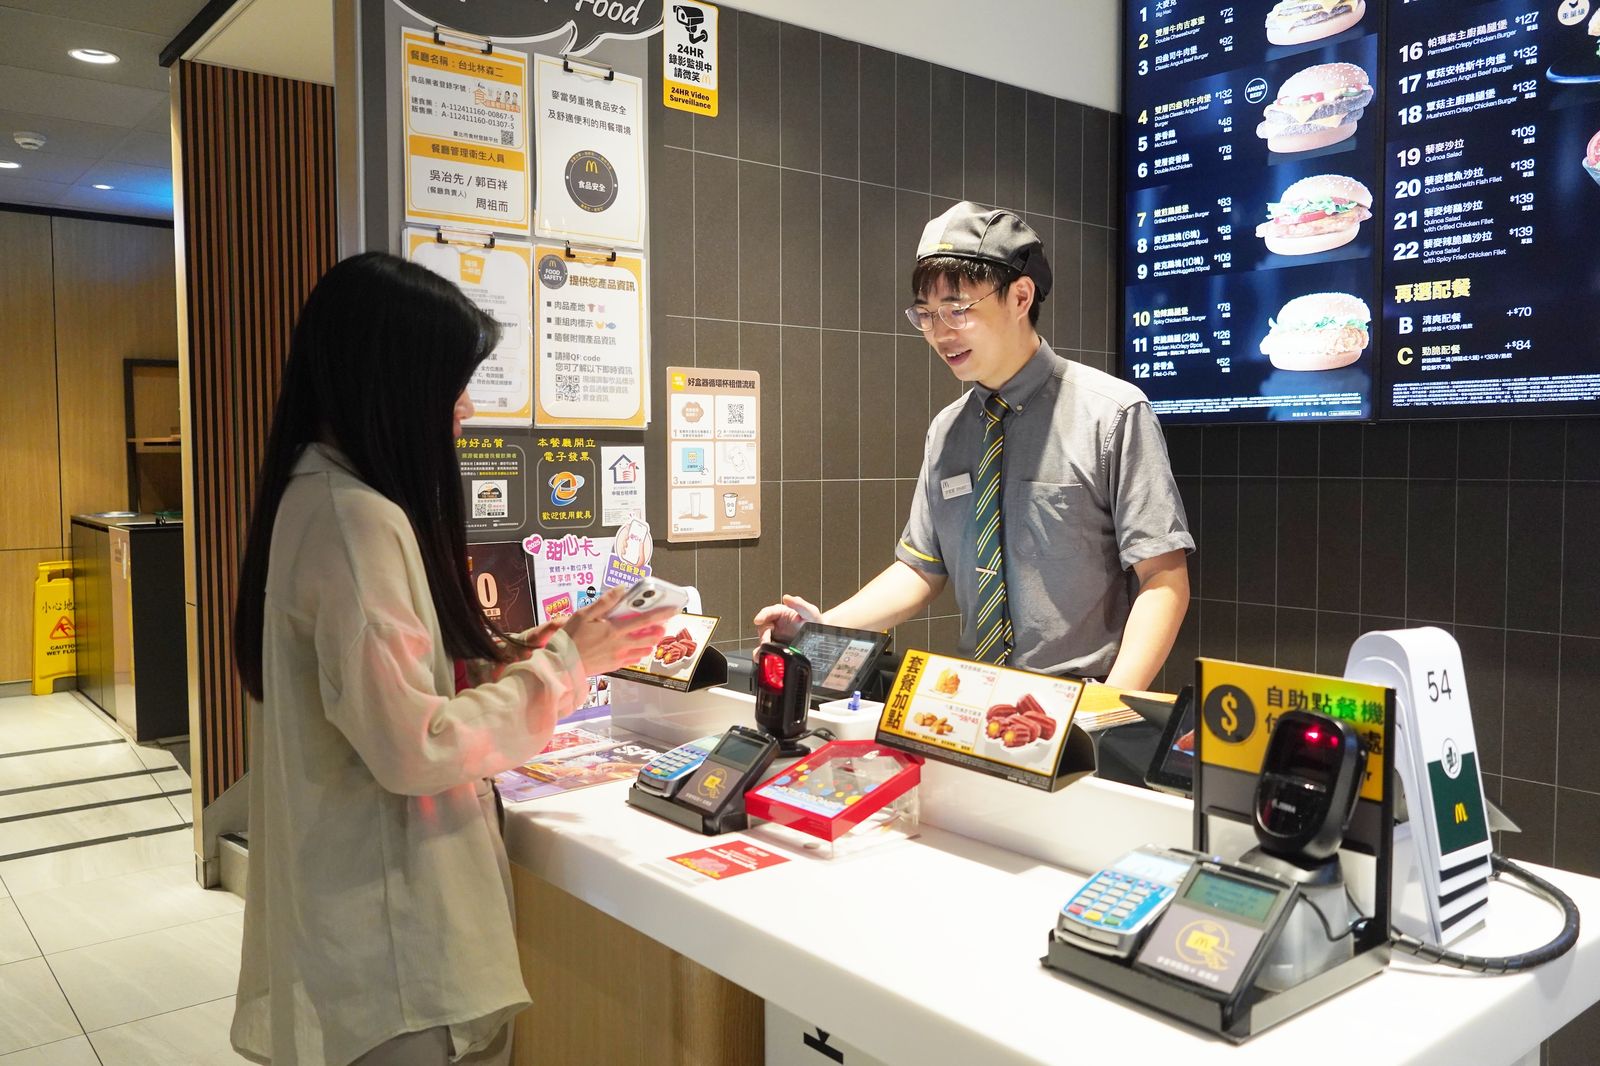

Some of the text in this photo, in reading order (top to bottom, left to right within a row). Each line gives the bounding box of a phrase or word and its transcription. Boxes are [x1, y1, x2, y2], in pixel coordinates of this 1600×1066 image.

[1139, 7, 1147, 22] 1
[1220, 8, 1233, 18] $72
[1515, 12, 1539, 25] $127
[1138, 34, 1149, 49] 2
[1155, 34, 1171, 45] Double
[1219, 36, 1233, 46] $92
[1427, 29, 1517, 56] Parmesan Crispy Chicken Burger
[677, 43, 704, 59] 24HR
[1194, 53, 1209, 63] Burger
[1399, 41, 1424, 63] 16
[1514, 45, 1538, 59] $132
[668, 53, 712, 74] 錄影監視中
[1138, 60, 1149, 75] 3
[673, 67, 700, 83] 請微笑
[1426, 63, 1513, 89] Mushroom Angus Beef Burger
[1398, 73, 1422, 95] 17
[1512, 80, 1537, 93] $132
[671, 86, 710, 102] 24HR Video
[1216, 89, 1232, 100] $132
[551, 90, 627, 116] 麥當勞重視食品安全
[669, 94, 712, 110] Surveillance
[1425, 95, 1518, 120] Mushroom Crispy Chicken Burger
[547, 108, 632, 136] 及舒適便利的用餐環境
[1138, 110, 1148, 125] 4
[1155, 112, 1170, 122] Double
[1218, 117, 1232, 127] $48
[1397, 105, 1423, 126] 18
[1155, 121, 1168, 129] Burger
[1511, 125, 1536, 138] $109
[1138, 136, 1148, 152] 5
[1154, 139, 1178, 148] McChicken
[1219, 145, 1232, 154] $78
[1425, 138, 1465, 155] 藜麥沙拉
[431, 143, 505, 164] 餐廳管理衛生人員
[1397, 147, 1421, 168] 19
[1425, 150, 1463, 163] Quinoa Salad
[1137, 162, 1148, 178] 6
[1154, 163, 1193, 175] Double McChicken
[1510, 159, 1535, 172] $139
[467, 175, 472, 187] /
[475, 176, 508, 191] 郭百祥
[578, 180, 606, 193] 食品安全
[1394, 178, 1422, 199] 20
[1424, 175, 1503, 195] Quinoa Salad with Fish Filet
[427, 186, 467, 199] (餐廳負責人)
[1510, 193, 1534, 205] $139
[476, 197, 508, 212] 周祖而
[1218, 197, 1231, 206] $83
[1137, 212, 1147, 228] 7
[1178, 211, 1210, 221] Chicken Burger
[1393, 210, 1418, 230] 21
[1424, 214, 1461, 226] Quinoa Salad
[1218, 225, 1231, 234] $68
[1423, 217, 1494, 233] with Grilled Chicken Filet
[1509, 226, 1533, 239] $139
[1137, 239, 1147, 254] 8
[1154, 242, 1171, 251] Chicken
[1393, 241, 1419, 262] 22
[1423, 246, 1460, 257] Quinoa Salad
[1214, 253, 1231, 263] $109
[1436, 255, 1452, 264] Spicy
[1452, 253, 1468, 261] Fried
[1468, 251, 1492, 259] Chicken
[1492, 248, 1506, 256] Filet
[543, 273, 563, 282] SAFETY
[545, 268, 561, 277] FOOD
[1137, 264, 1148, 280] 9
[569, 275, 636, 292] 提供您產品資訊
[1395, 277, 1471, 304] 再選配餐
[554, 301, 585, 313] 肉品產地
[1217, 303, 1231, 312] $78
[1506, 306, 1532, 318] +$70
[554, 317, 593, 329] 重組肉標示
[1133, 311, 1151, 327] 10
[1398, 316, 1414, 335] B
[1422, 312, 1461, 326] 清爽配餐
[554, 333, 616, 346] 隨餐附贈產品資訊
[1133, 338, 1147, 352] 11
[1505, 339, 1531, 350] +$84
[583, 353, 601, 362] code
[1217, 358, 1230, 367] $52
[1397, 347, 1414, 365] C
[555, 362, 633, 375] 您可了解以下即時資訊
[1132, 363, 1150, 378] 12
[687, 378, 756, 389] 好盒器循環杯租借流程
[456, 438, 504, 449] 持好品質
[537, 438, 596, 449] 本餐廳開立
[543, 452, 591, 462] 電子發票
[541, 510, 592, 521] 歡迎使用載具
[546, 536, 600, 561] 甜心卡
[550, 571, 594, 585] 雙享價 $39
[477, 572, 498, 608] 0
[42, 598, 76, 614] 小心地
[1427, 668, 1452, 703] 54
[885, 655, 923, 731] 套餐加點
[1266, 686, 1384, 726] 自助點餐機
